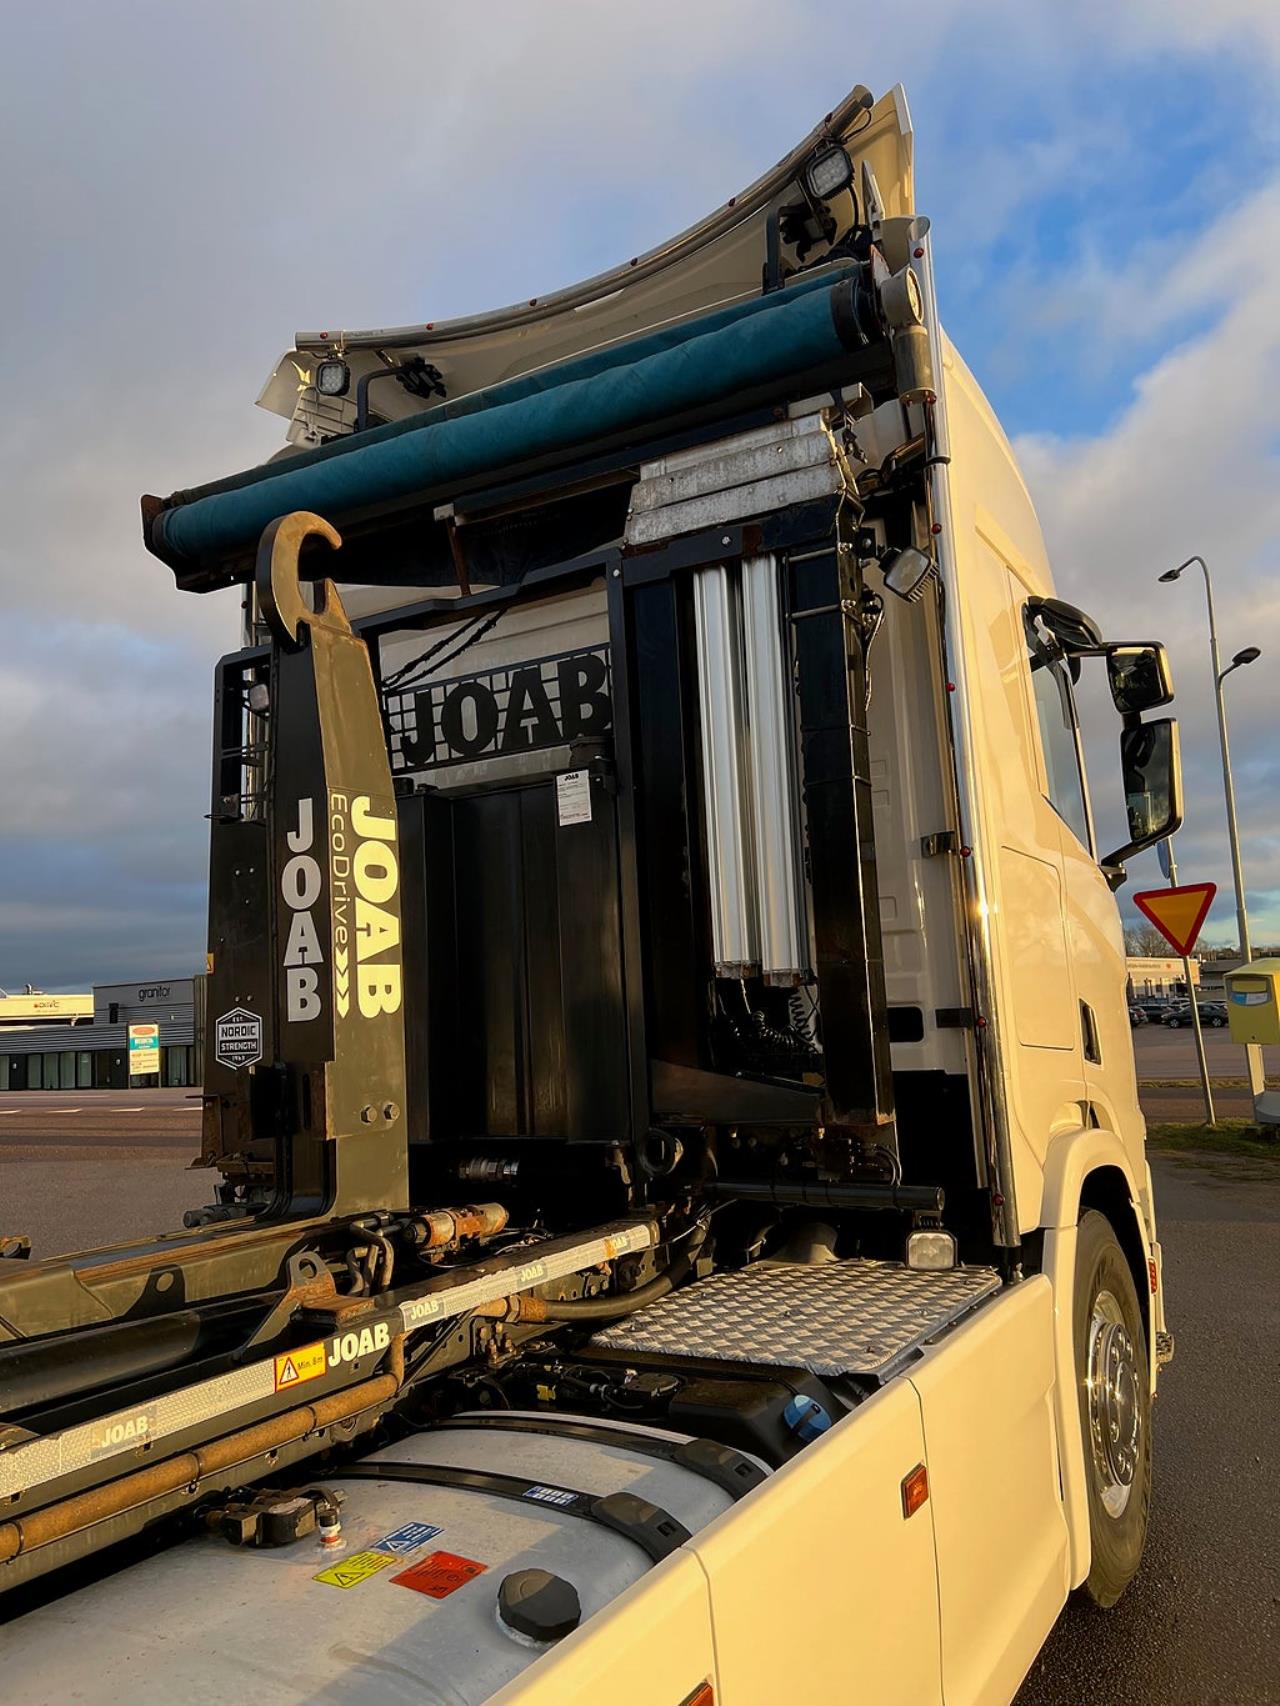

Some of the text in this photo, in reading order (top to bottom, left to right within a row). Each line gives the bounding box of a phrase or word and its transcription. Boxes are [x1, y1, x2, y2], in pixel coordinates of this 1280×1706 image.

[400, 654, 613, 766] JOAB
[330, 793, 350, 944] EcoDrive
[281, 797, 324, 1022] JOAB
[351, 795, 402, 1018] JOAB
[138, 986, 171, 1001] granitor
[221, 1025, 256, 1038] NORDIC
[221, 1041, 257, 1051] STRENGTH
[608, 1236, 627, 1249] OAB
[520, 1264, 543, 1282] JOAB
[410, 1300, 439, 1320] JOAB
[328, 1322, 390, 1367] JOAB
[101, 1415, 148, 1448] JOAB
